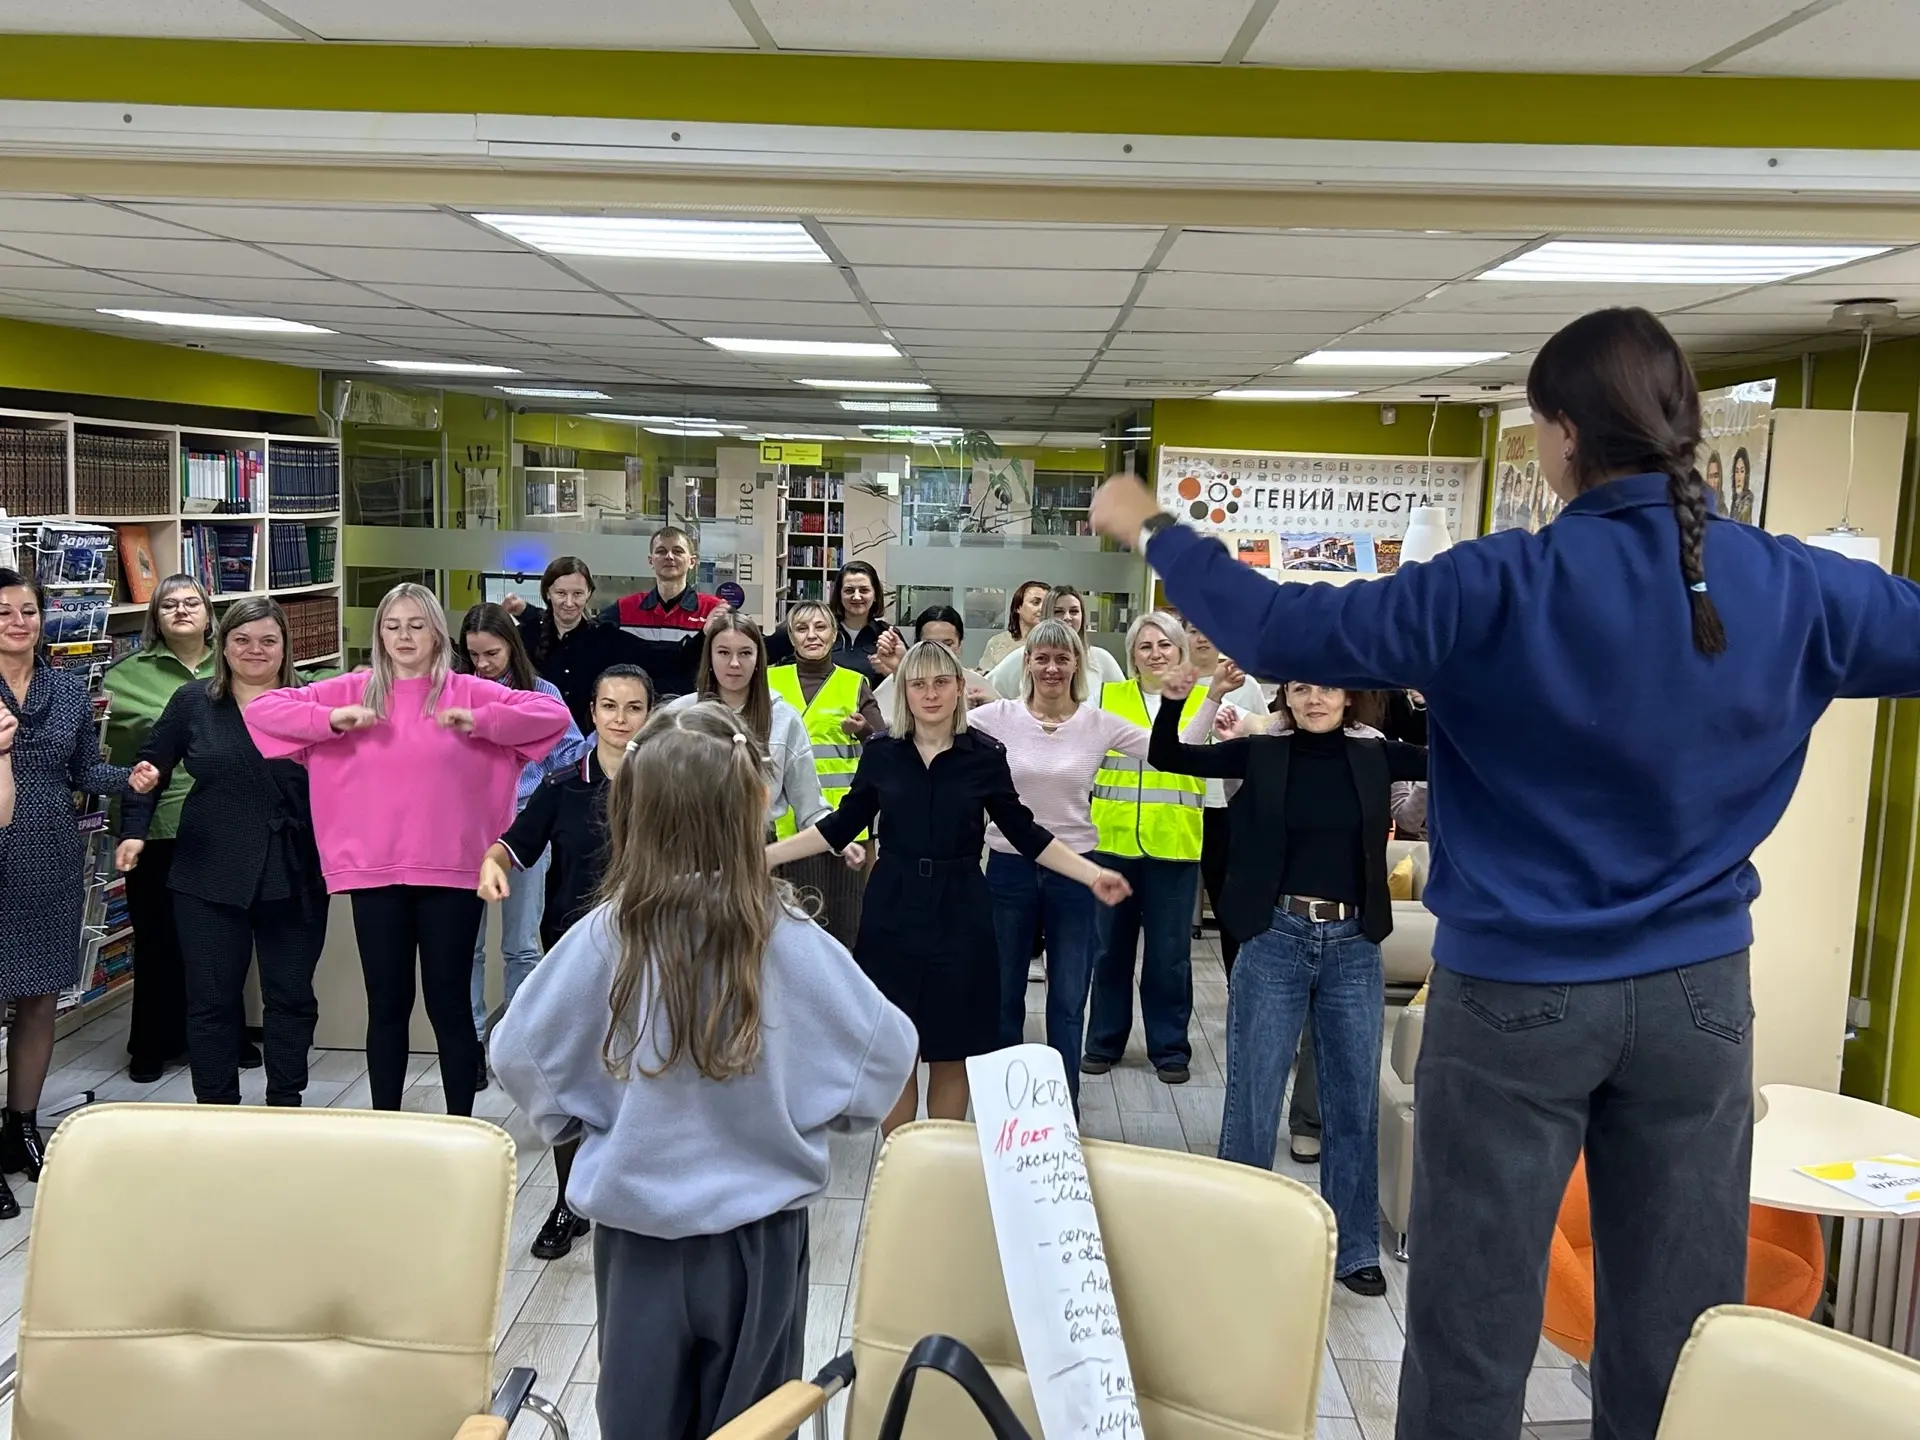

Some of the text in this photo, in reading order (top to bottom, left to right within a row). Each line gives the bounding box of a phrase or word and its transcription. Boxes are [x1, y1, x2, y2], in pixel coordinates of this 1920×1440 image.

[1254, 488, 1429, 513] ГЕНИЙ МЕСТА
[994, 1117, 1018, 1158] 18
